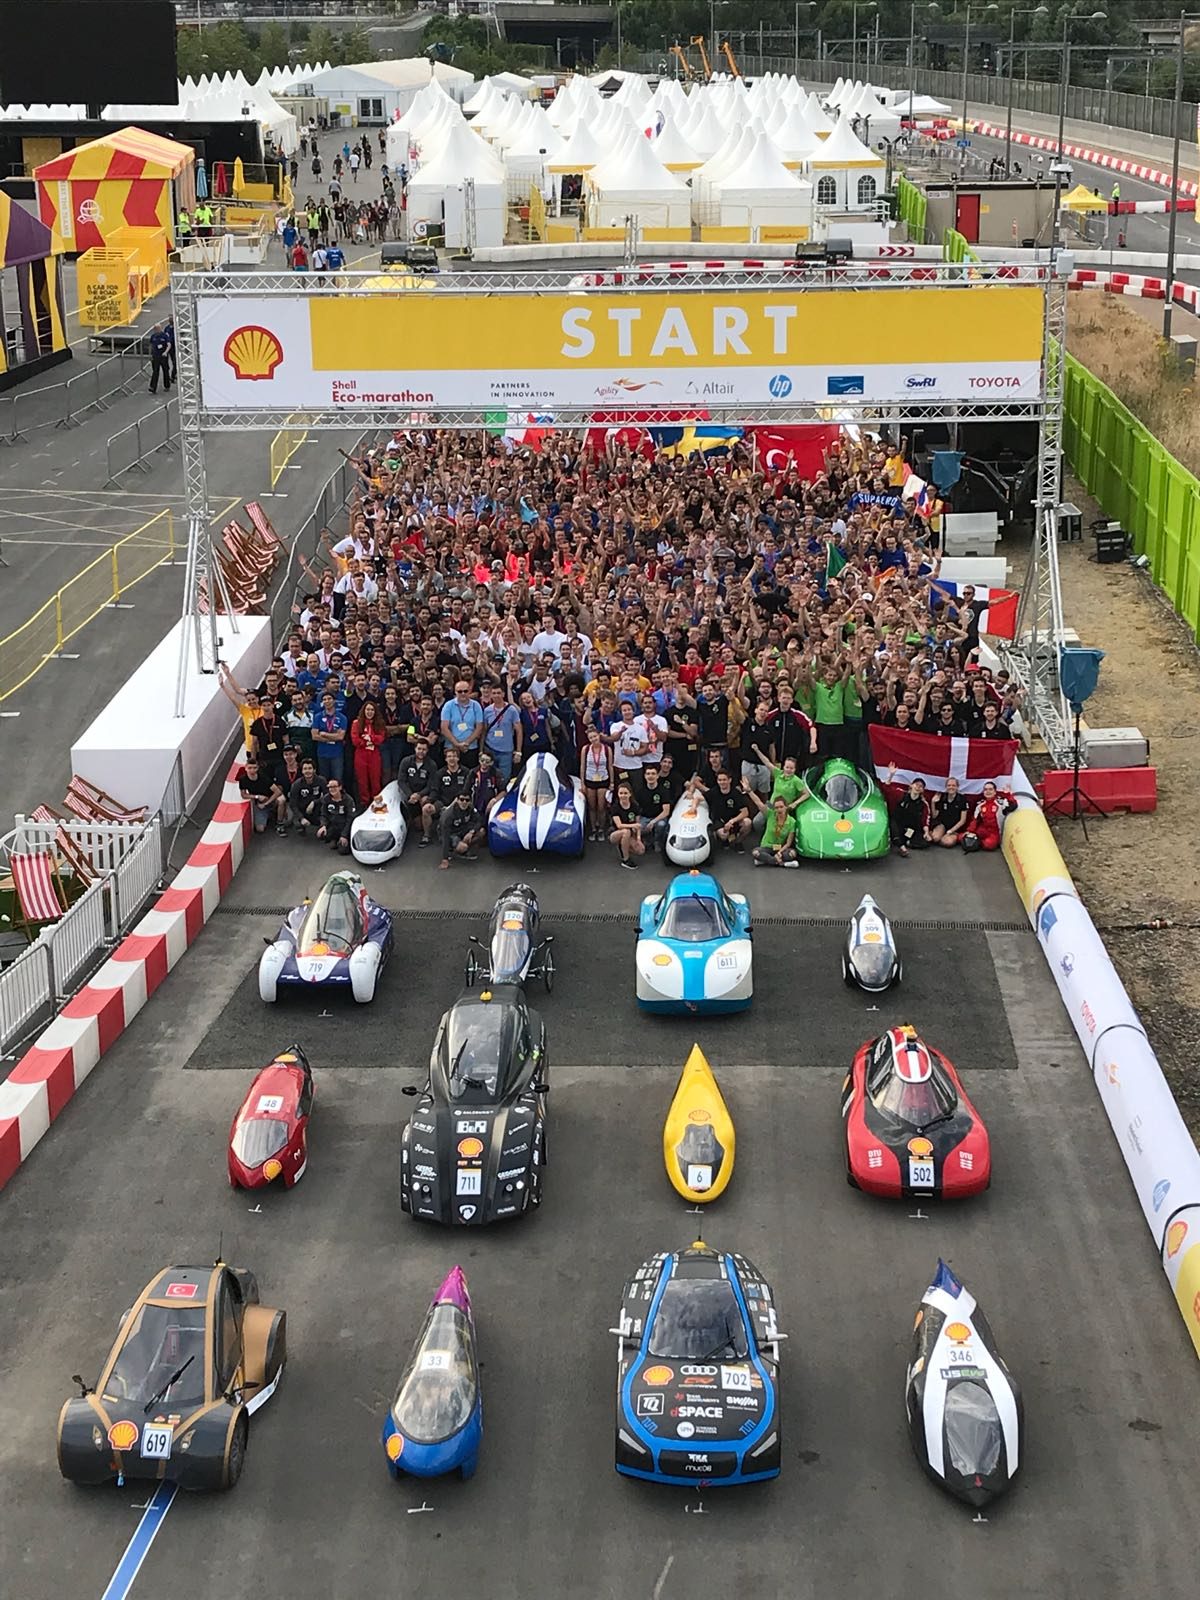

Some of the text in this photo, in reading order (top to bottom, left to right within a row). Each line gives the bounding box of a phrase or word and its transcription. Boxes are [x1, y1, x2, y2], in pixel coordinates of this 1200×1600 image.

[560, 305, 797, 358] START
[332, 380, 357, 390] Shell
[772, 375, 790, 398] hp
[906, 376, 937, 388] SwRI
[968, 377, 1021, 388] TOYOTA
[593, 386, 618, 396] Agility
[702, 382, 735, 395] Altair
[332, 390, 433, 402] Eco-marathon
[309, 963, 323, 972] 719
[720, 958, 733, 966] 611
[265, 1100, 277, 1108] 48
[697, 1171, 703, 1183] 6
[913, 1168, 931, 1181] 502
[461, 1177, 476, 1190] 711
[428, 1355, 442, 1366] 33
[950, 1350, 972, 1362] 346
[725, 1373, 747, 1386] 702
[643, 1396, 660, 1412] TQ
[671, 1406, 723, 1418] dSPACE
[146, 1433, 166, 1452] 619
